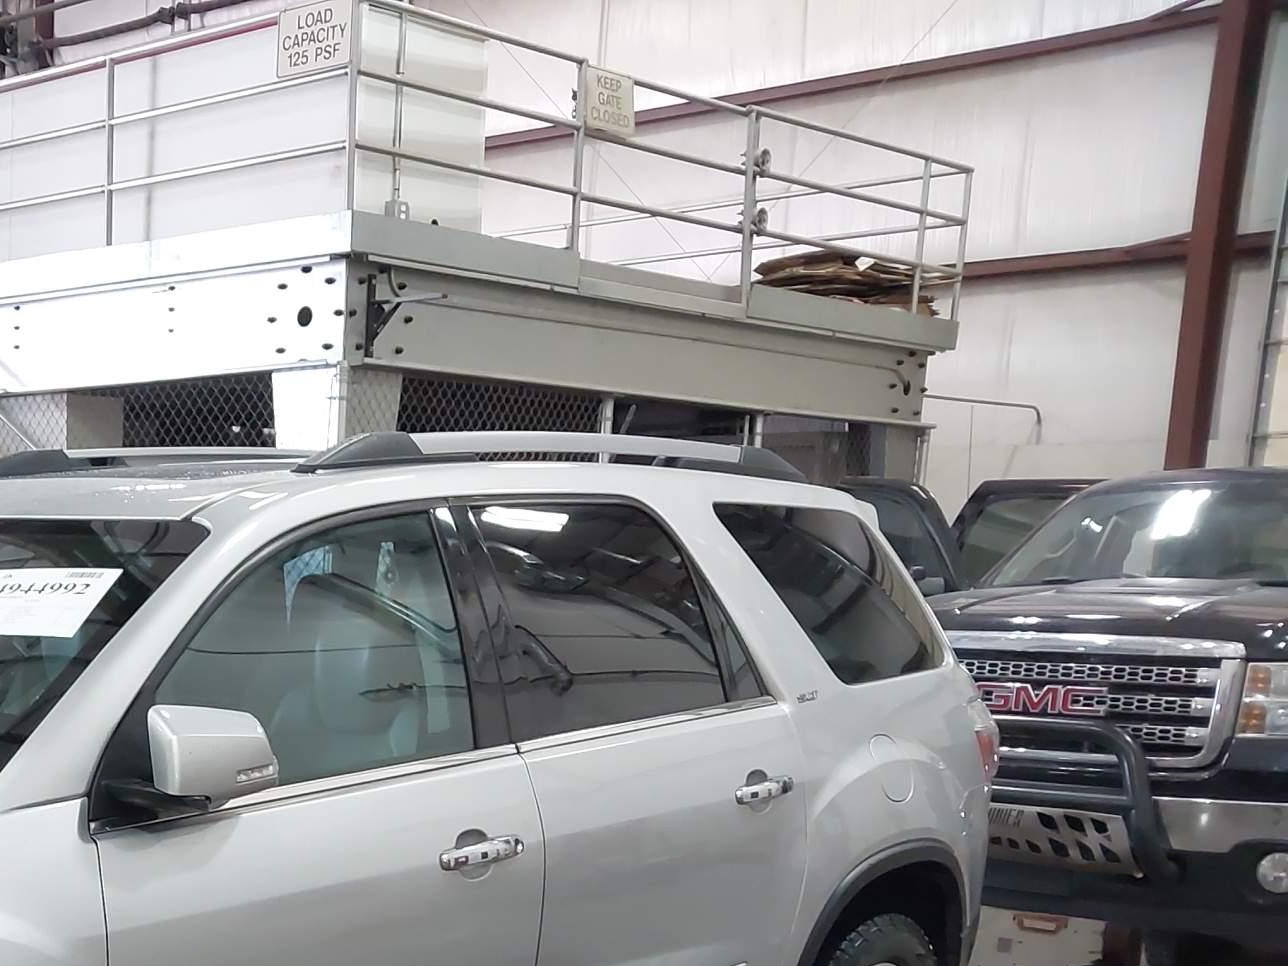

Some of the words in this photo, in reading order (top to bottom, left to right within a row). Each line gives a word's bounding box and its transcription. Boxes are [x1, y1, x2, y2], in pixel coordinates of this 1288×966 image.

[297, 8, 333, 29] LOAD
[282, 22, 347, 51] CAPACITY
[288, 49, 309, 67] 125
[315, 42, 341, 62] PSF
[597, 74, 622, 92] KEEP
[598, 91, 623, 109] GATE
[591, 106, 630, 128] CLOSED
[976, 681, 1109, 716] GMC
